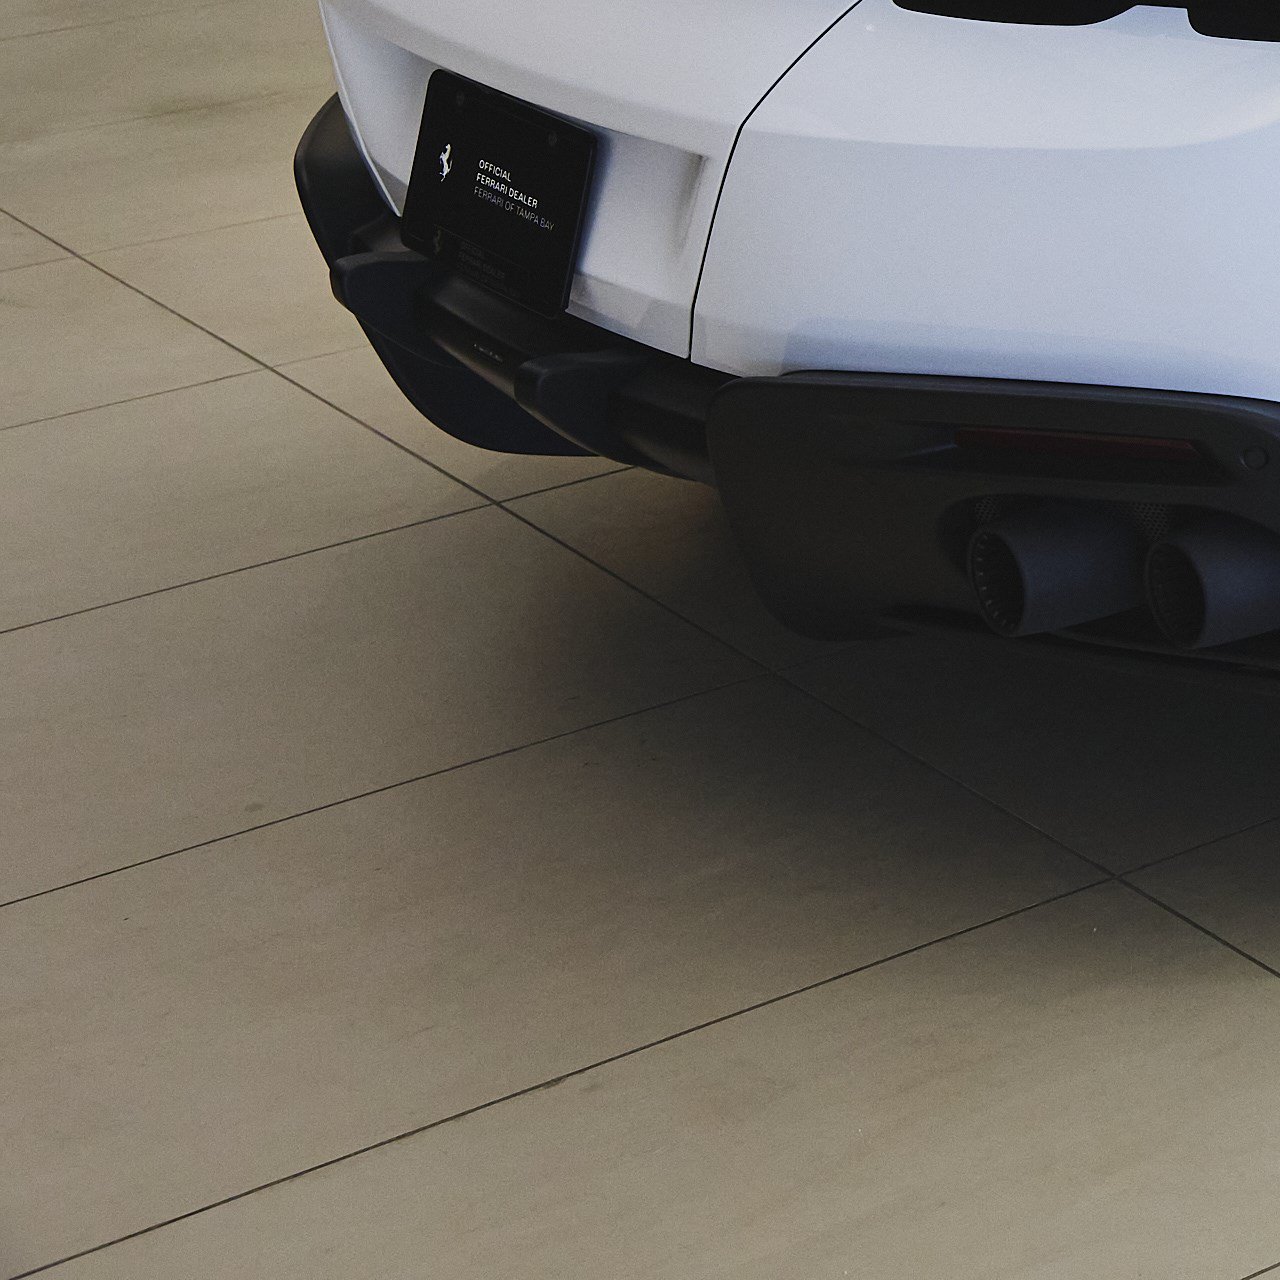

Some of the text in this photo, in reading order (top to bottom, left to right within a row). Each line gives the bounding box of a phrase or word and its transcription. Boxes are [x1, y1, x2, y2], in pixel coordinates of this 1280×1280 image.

[478, 159, 512, 182] OFFICIAL
[473, 186, 555, 231] FERRARI OF TAMPA BAY
[476, 172, 539, 209] FERRARI DEALER
